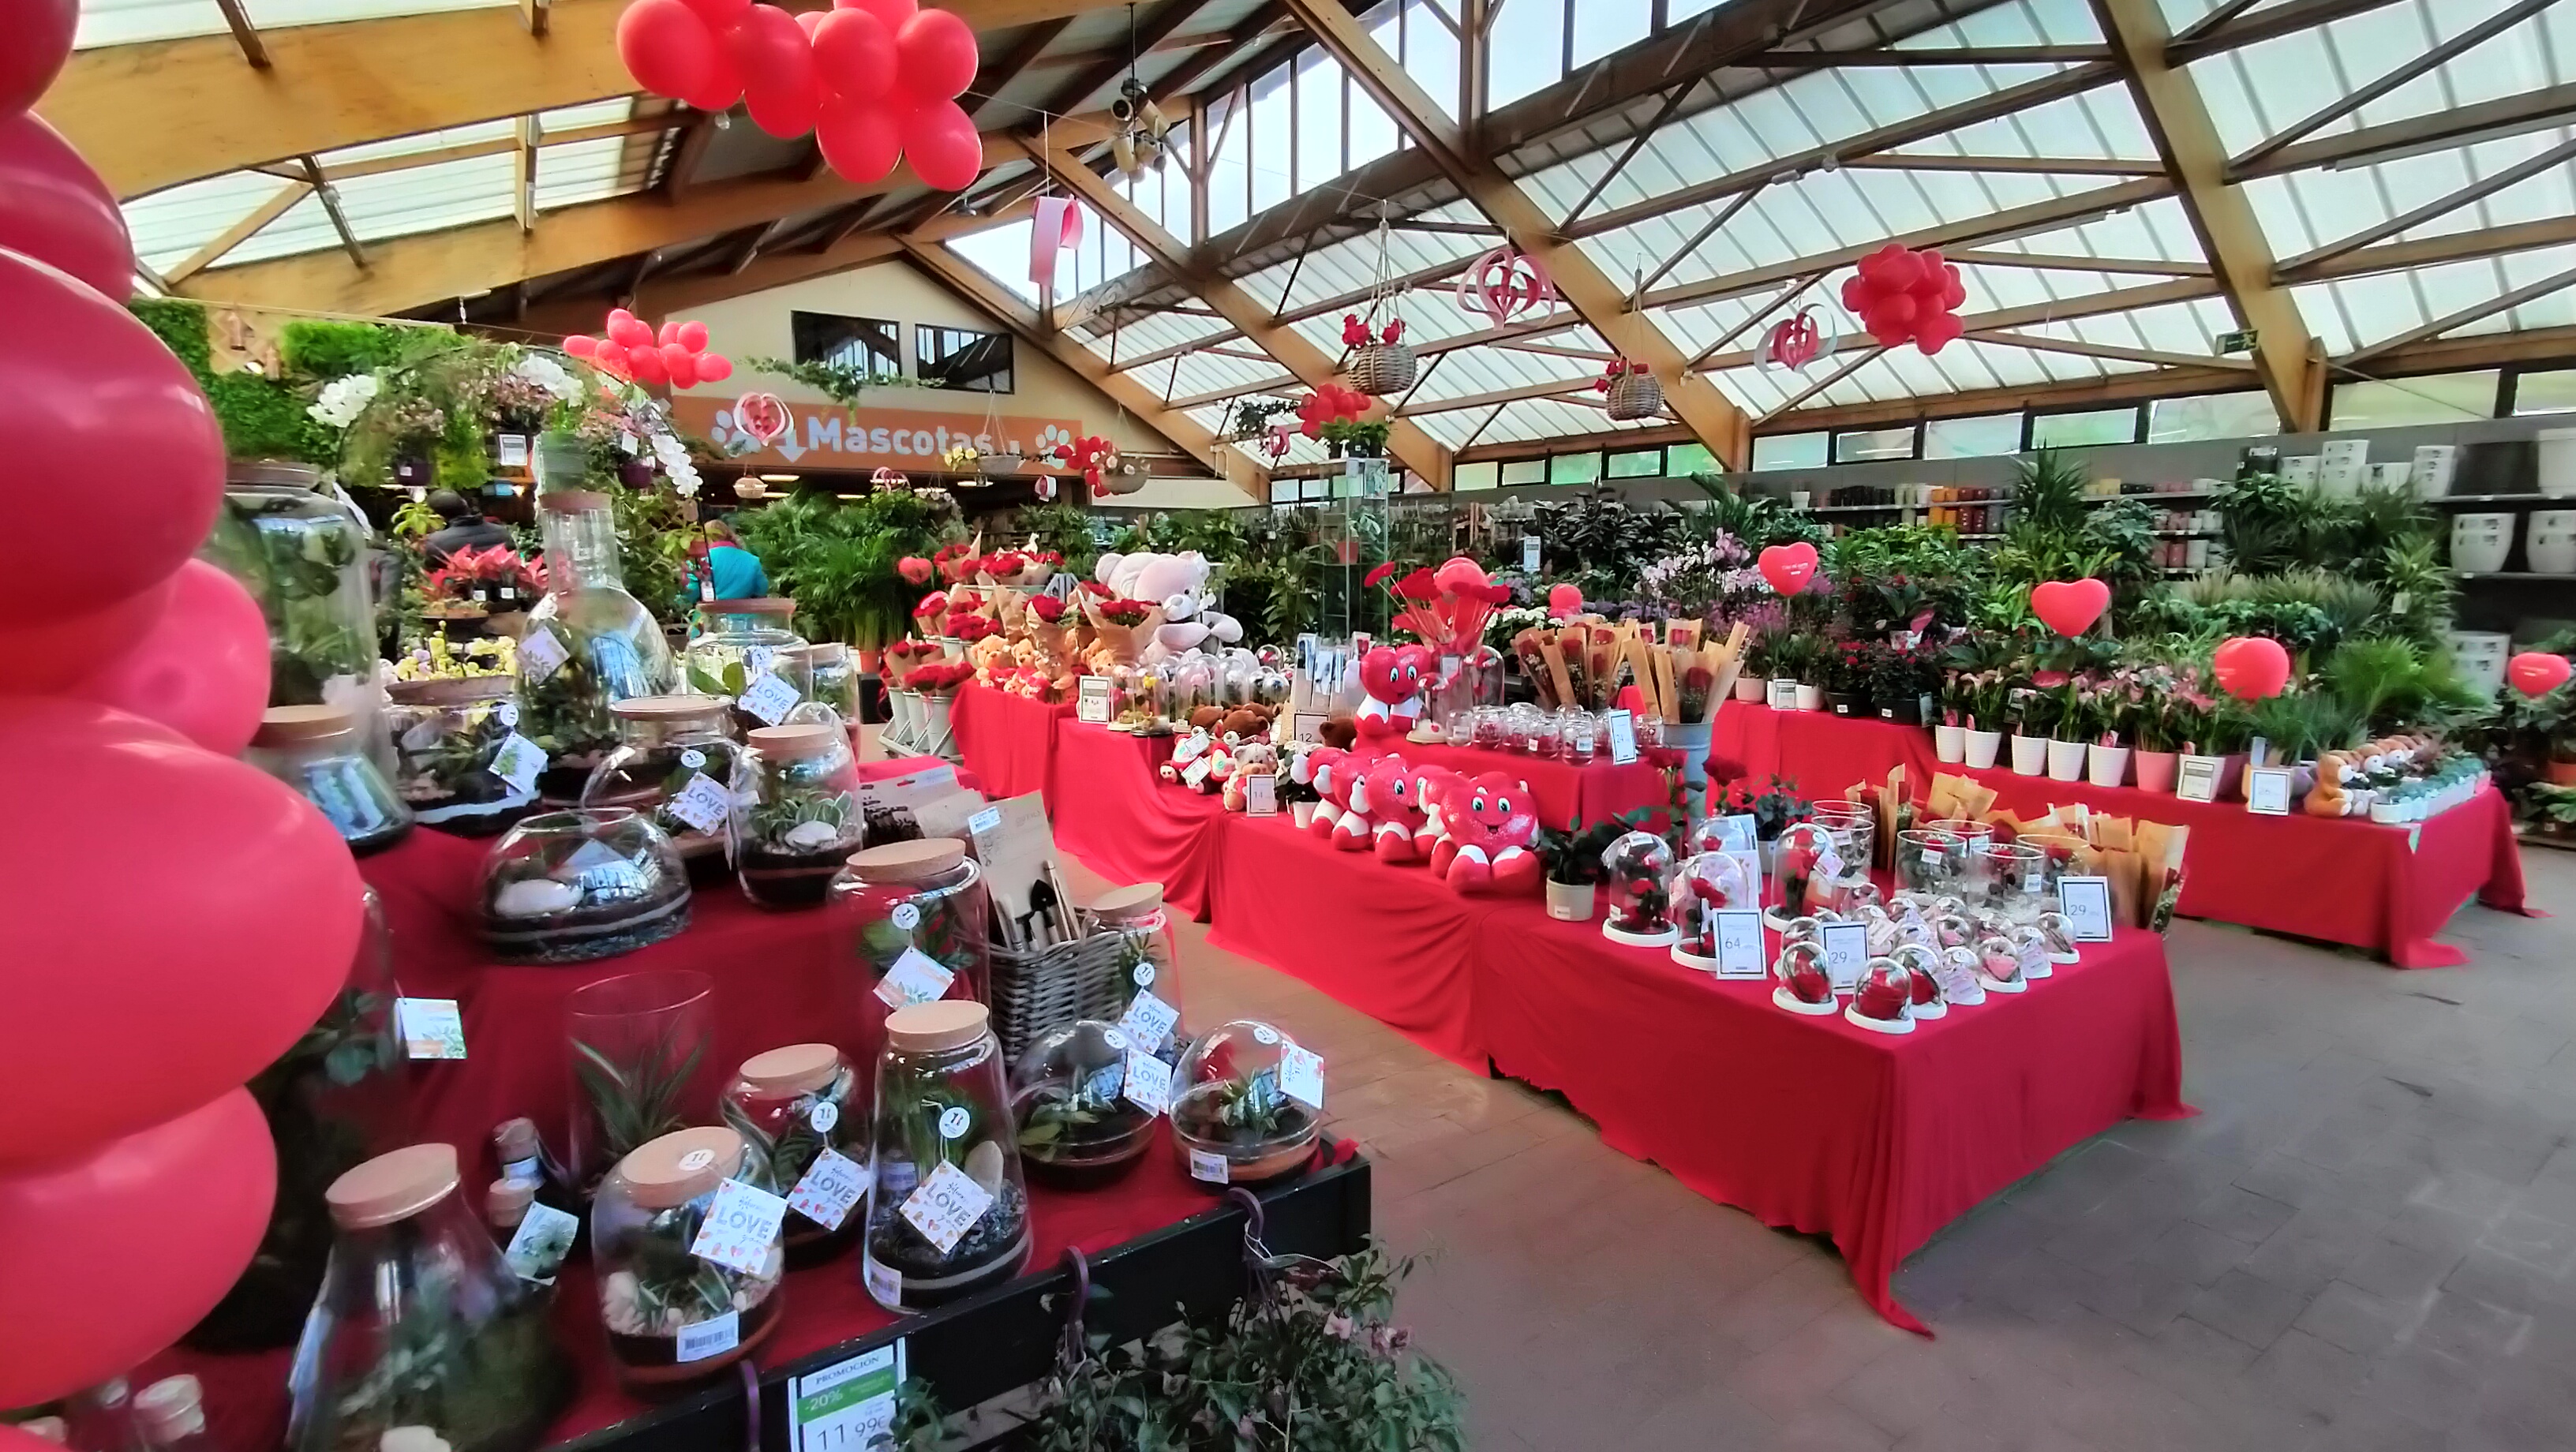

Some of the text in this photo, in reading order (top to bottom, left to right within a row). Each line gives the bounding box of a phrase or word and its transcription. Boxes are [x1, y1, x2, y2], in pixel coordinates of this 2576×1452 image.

[807, 416, 993, 456] Mascotas
[756, 683, 789, 709] LOVE
[1299, 732, 1312, 743] 12
[687, 787, 725, 817] LOVE
[2070, 904, 2087, 916] 29
[1724, 937, 1741, 949] 64
[1831, 951, 1848, 964] 29
[1133, 1006, 1167, 1034] LOVE
[1133, 1065, 1166, 1091] LOVE
[810, 1169, 856, 1204] LOVE
[926, 1182, 971, 1227] LOVE
[716, 1205, 773, 1240] LOVE
[815, 1355, 880, 1385] PROMOCIÓN
[804, 1389, 844, 1412] -20%
